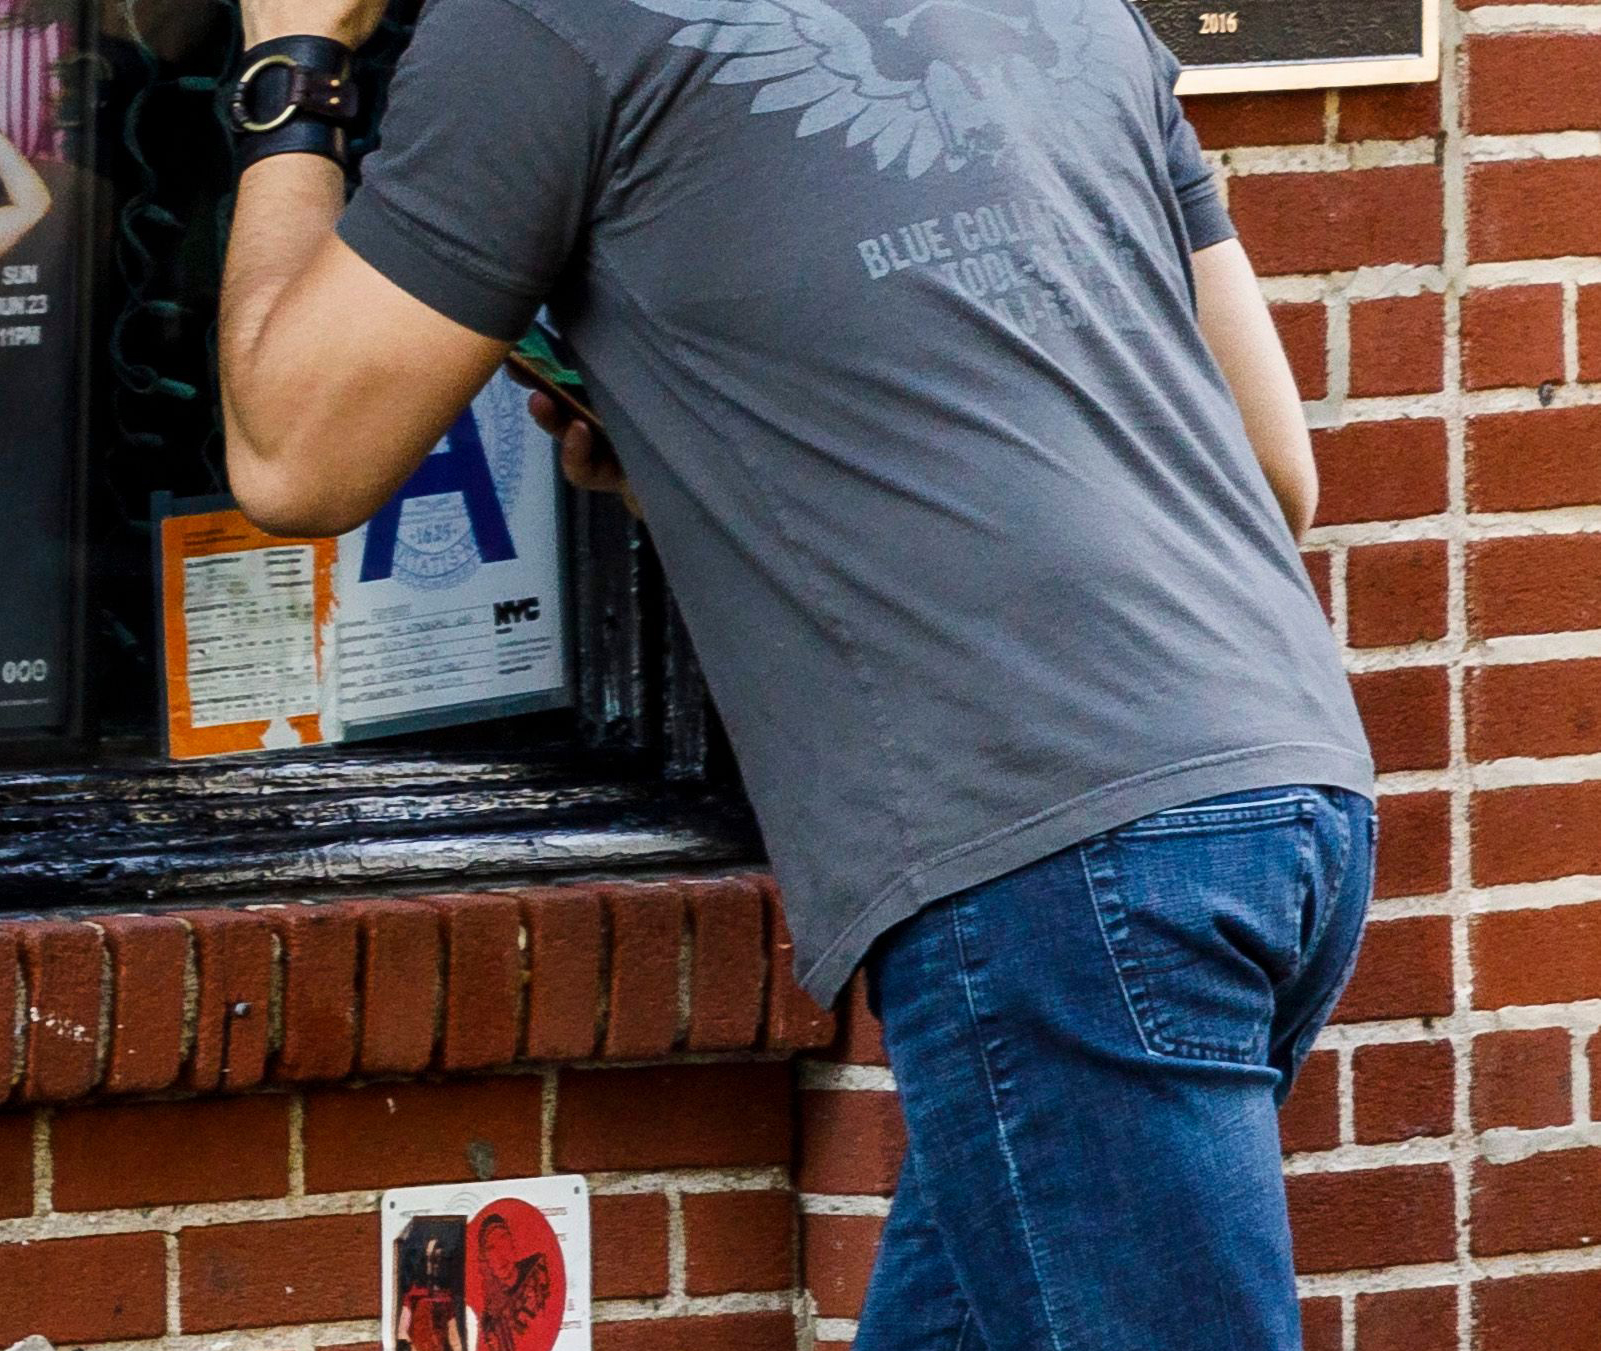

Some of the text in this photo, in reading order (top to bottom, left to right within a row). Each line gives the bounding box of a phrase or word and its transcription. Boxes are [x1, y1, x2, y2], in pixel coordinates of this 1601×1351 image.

[1199, 13, 1237, 34] 2016
[858, 217, 953, 280] BLUE
[2, 265, 39, 285] SUN
[27, 294, 48, 314] 23
[493, 597, 540, 626] NYC
